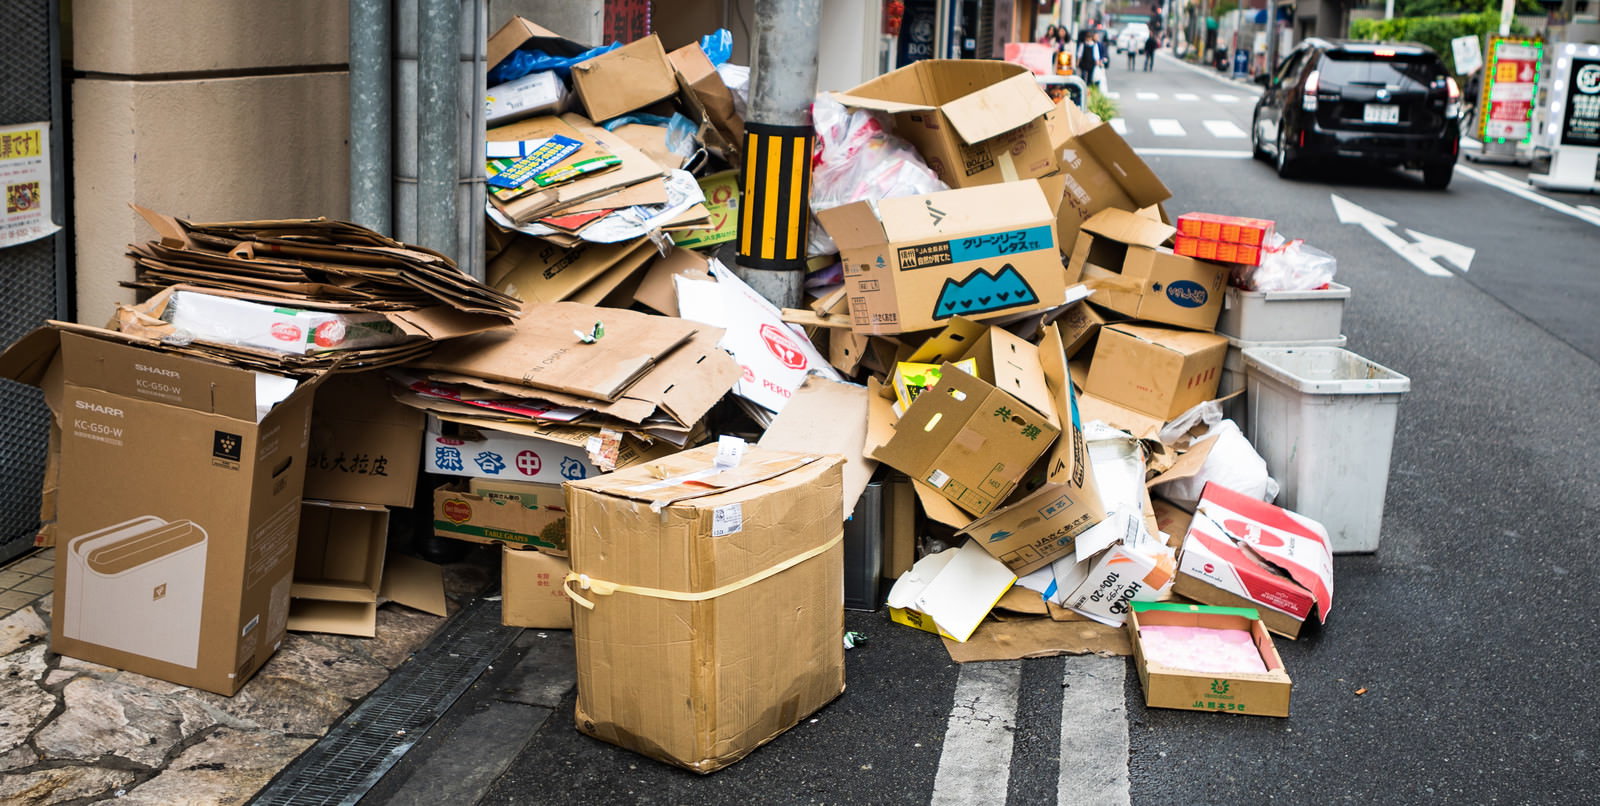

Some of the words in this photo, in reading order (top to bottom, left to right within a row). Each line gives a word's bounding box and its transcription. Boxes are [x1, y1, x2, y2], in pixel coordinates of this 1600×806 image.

[963, 231, 1027, 249] グリーンリーフ
[135, 363, 180, 380] SHARP
[135, 378, 181, 395] KC-G50-W
[74, 400, 124, 418] SHARP
[74, 418, 123, 438] KC-G50-W
[484, 529, 504, 539] TABLE
